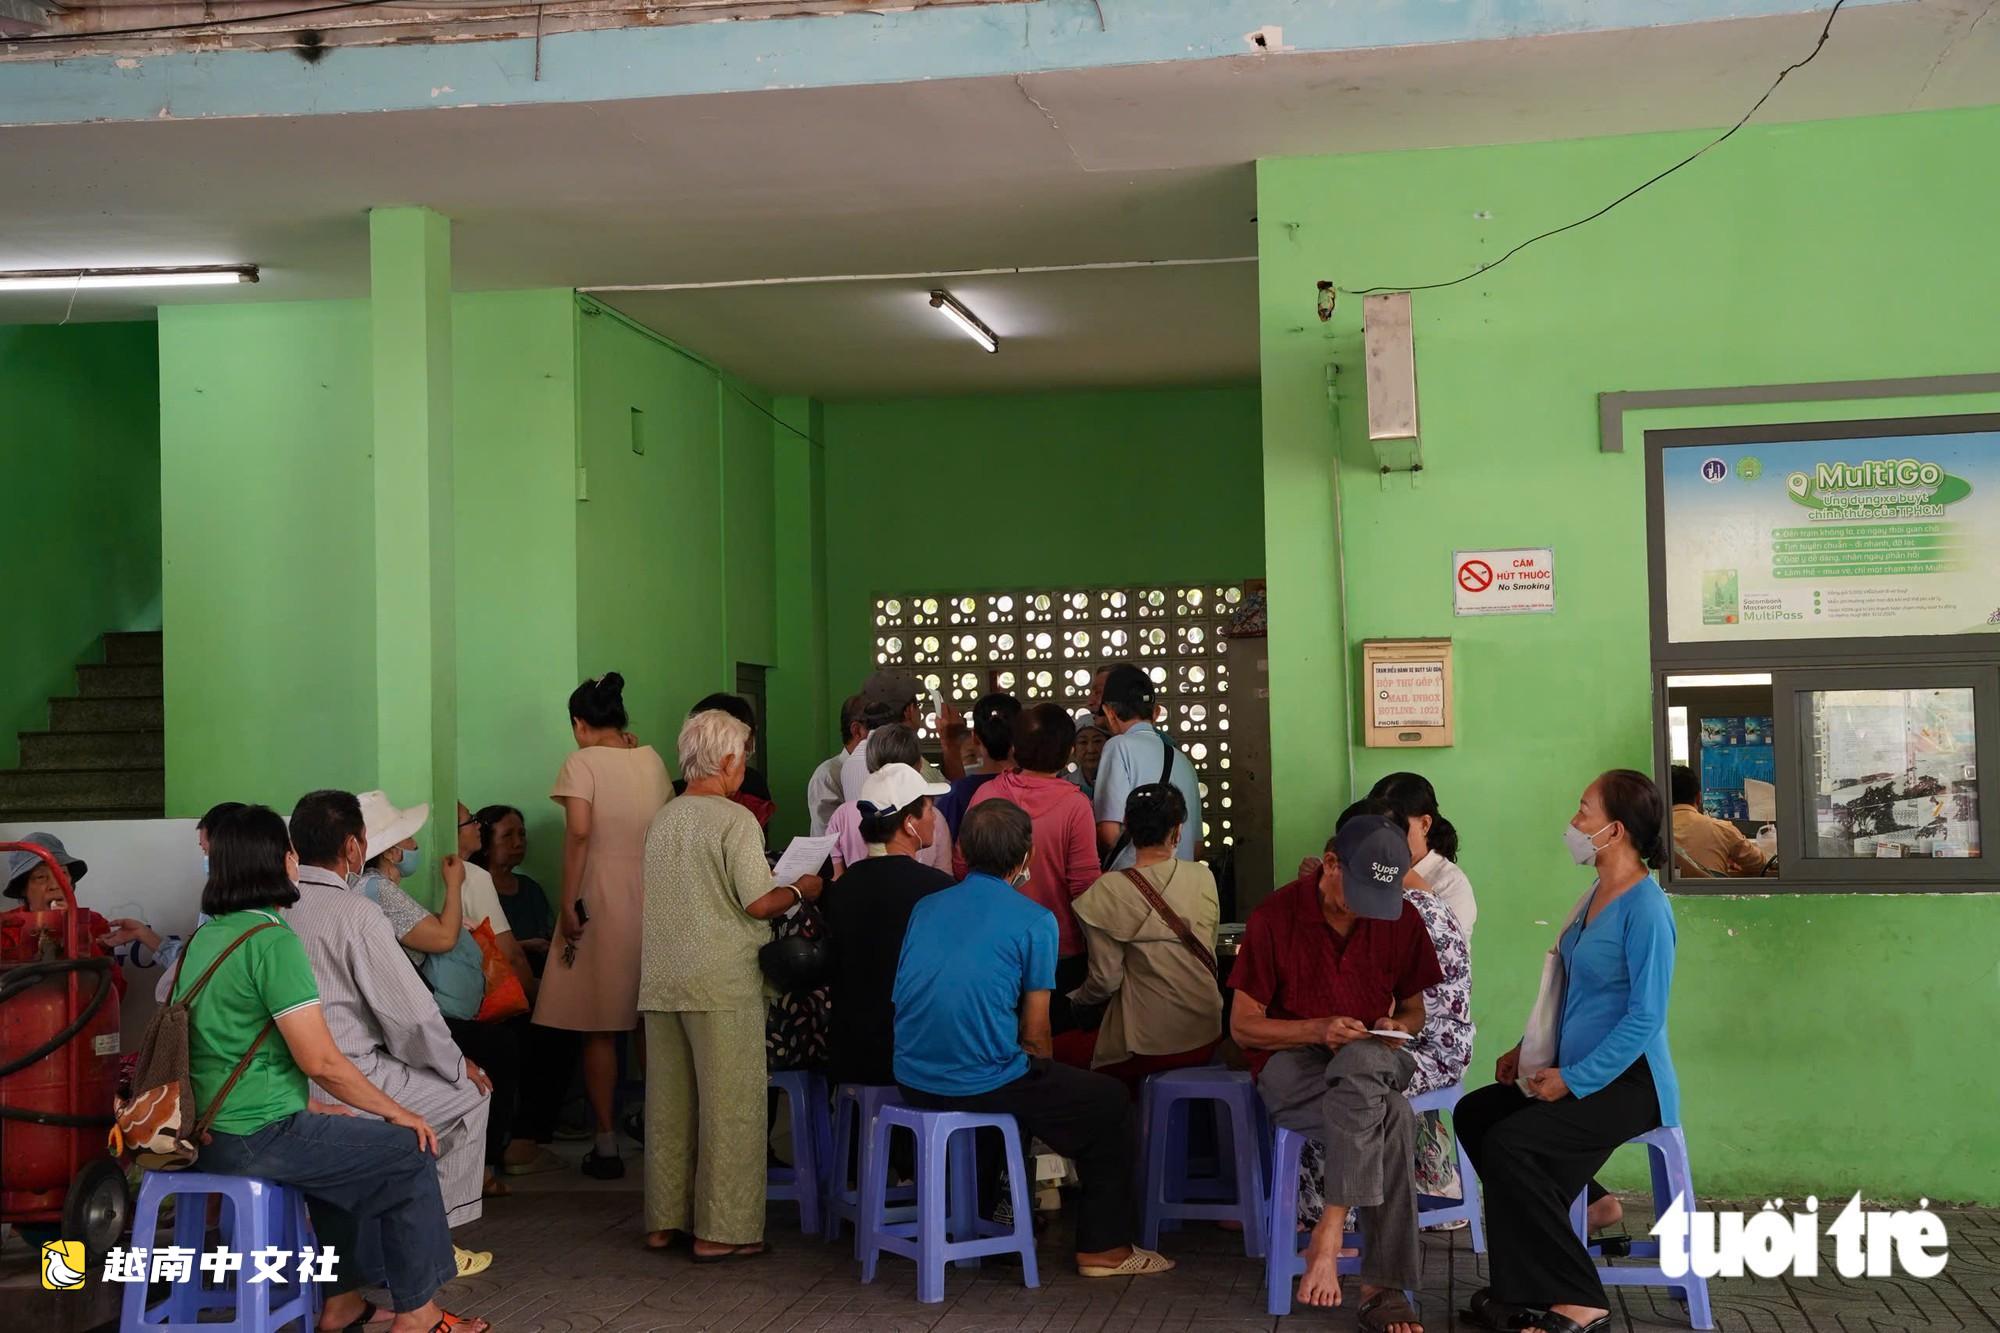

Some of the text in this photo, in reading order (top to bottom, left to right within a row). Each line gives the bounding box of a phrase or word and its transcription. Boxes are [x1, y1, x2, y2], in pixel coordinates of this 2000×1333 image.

[1818, 460, 1940, 490] MultiGo
[1824, 491, 1929, 508] Ứng dụng xe buýt
[1808, 504, 1943, 520] chính thức của TPHCM
[1497, 570, 1516, 580] HÚT
[1512, 582, 1550, 591] Smoking
[1743, 610, 1804, 621] MultiPass
[1420, 706, 1440, 714] 1022
[1371, 861, 1399, 875] SUPER
[1373, 871, 1394, 883] XAO
